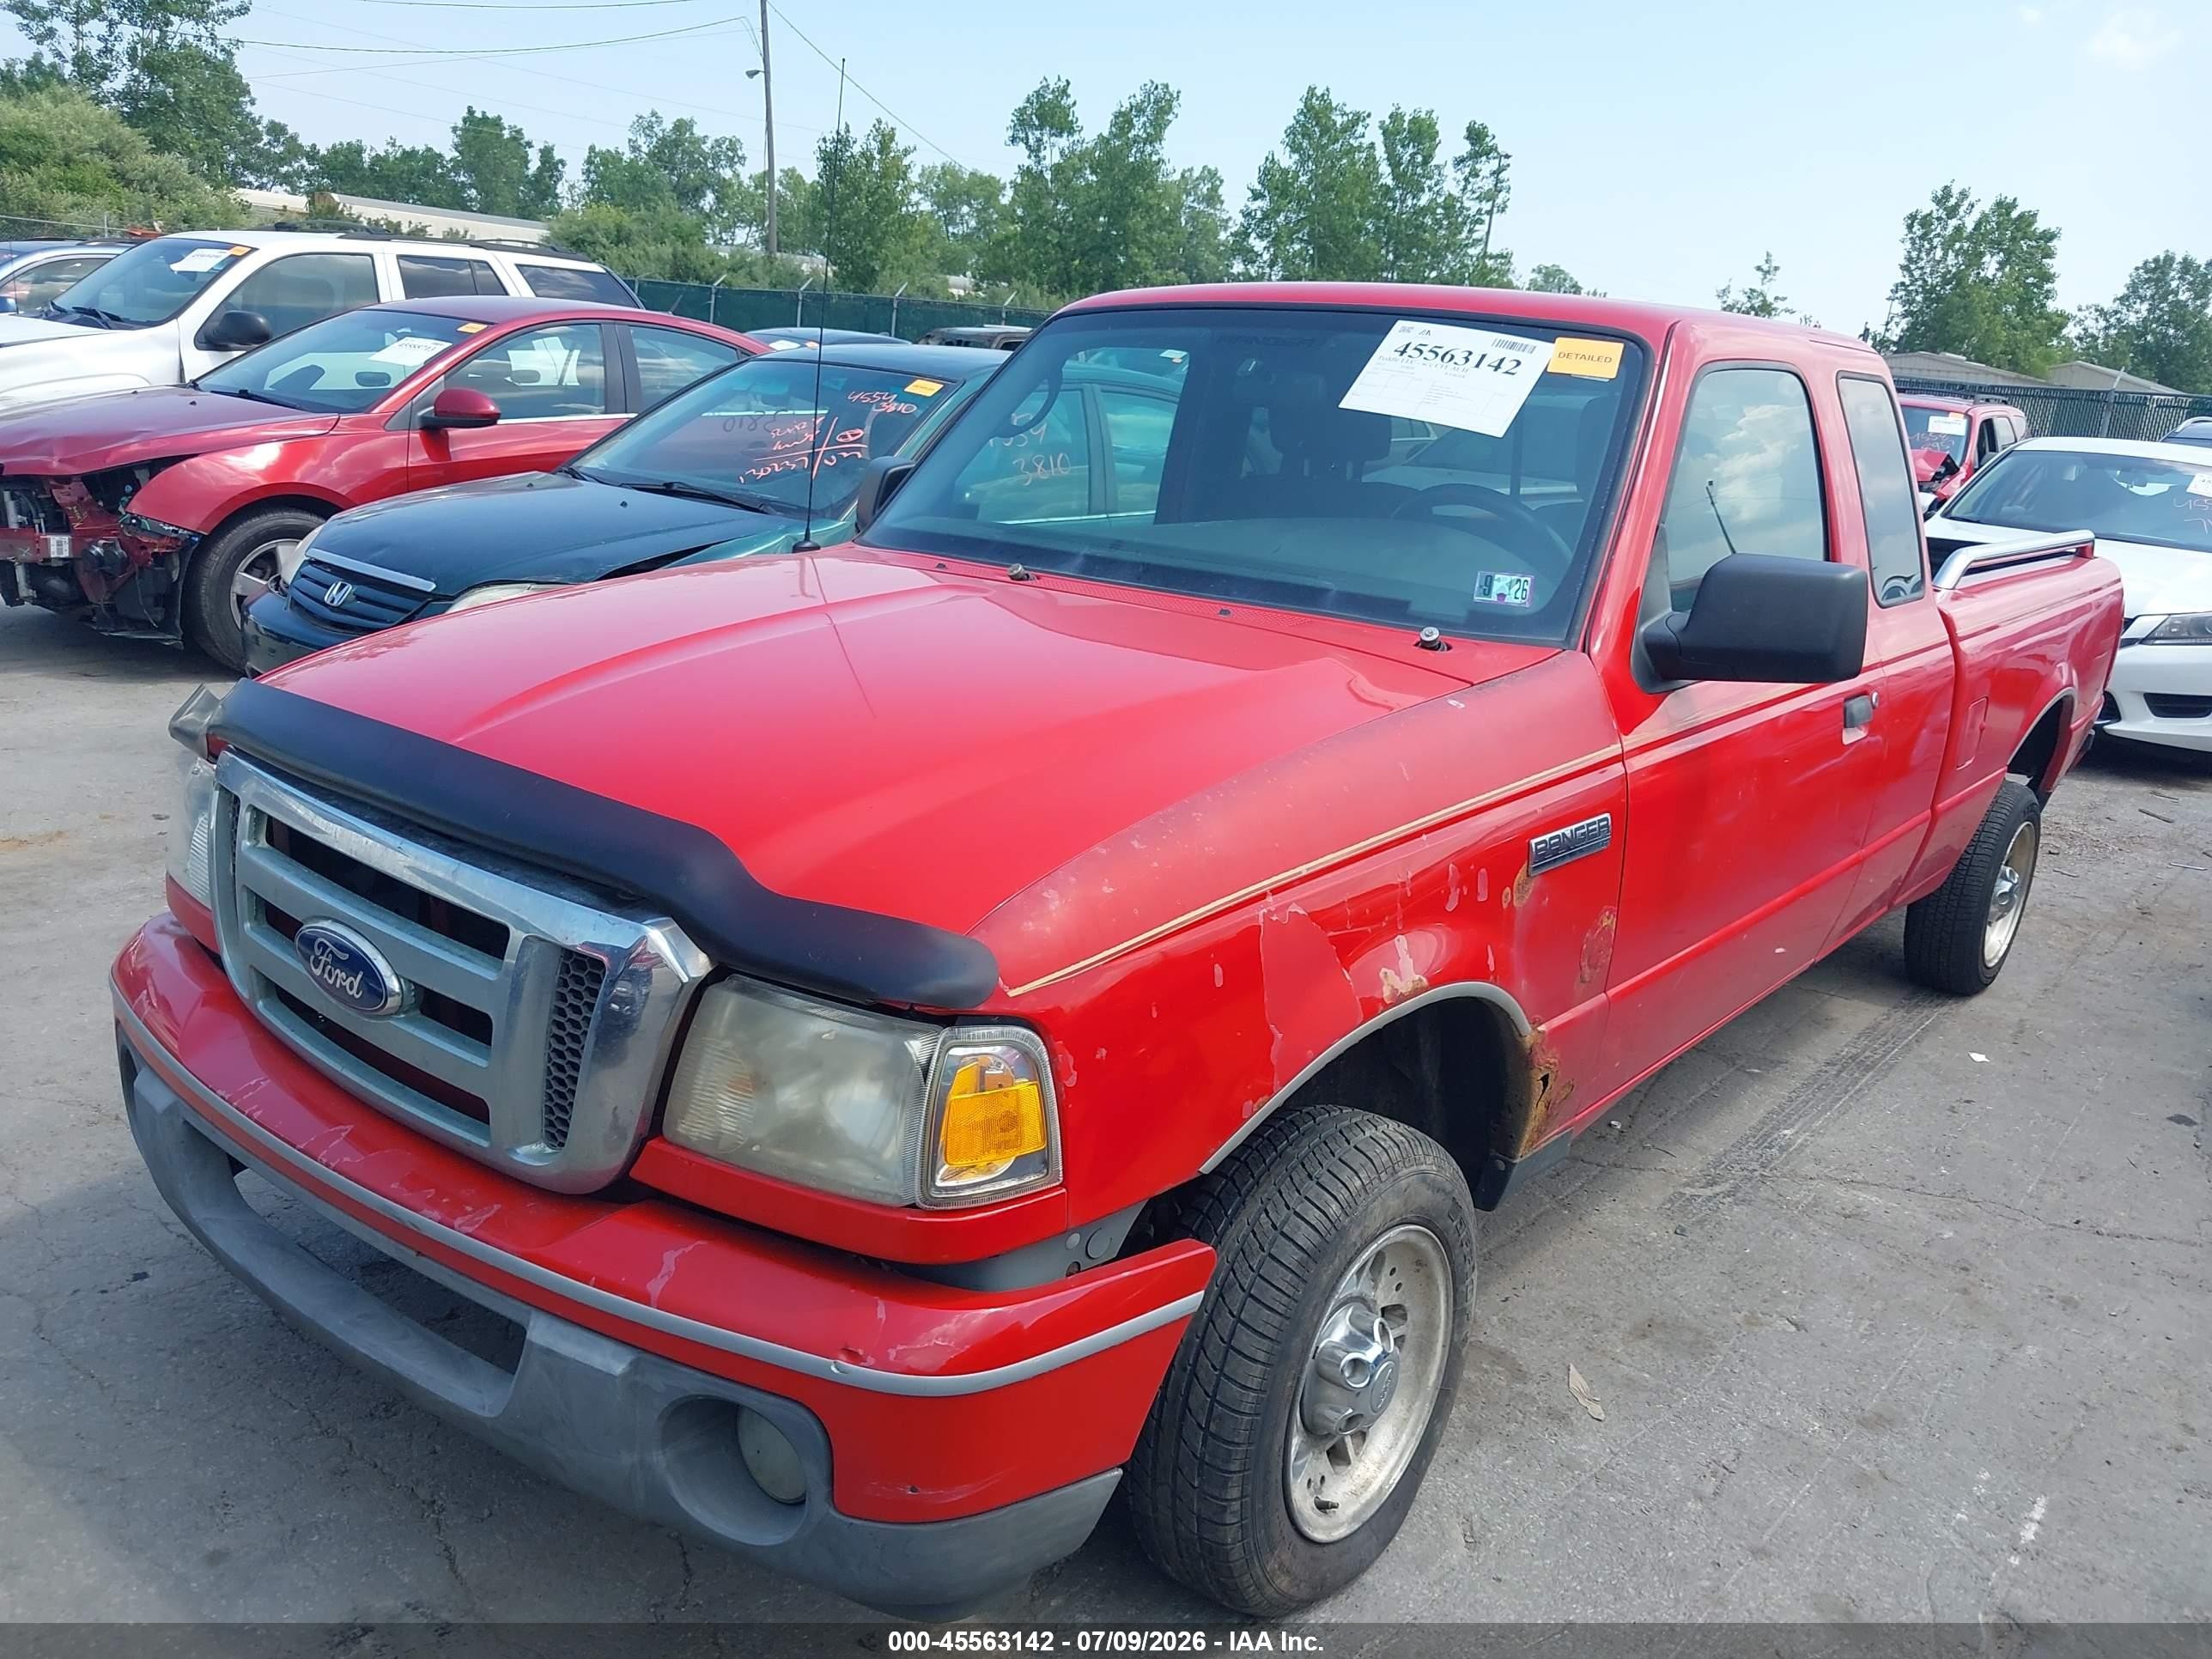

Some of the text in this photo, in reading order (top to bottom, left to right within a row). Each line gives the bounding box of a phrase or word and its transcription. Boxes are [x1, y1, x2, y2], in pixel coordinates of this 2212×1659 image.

[1395, 342, 1522, 375] 45563142
[1558, 351, 1613, 363] DETAILED
[1012, 453, 1073, 486] 3810
[1514, 579, 1529, 600] 26
[1532, 817, 1611, 862] RANGER
[310, 938, 364, 999] Ford
